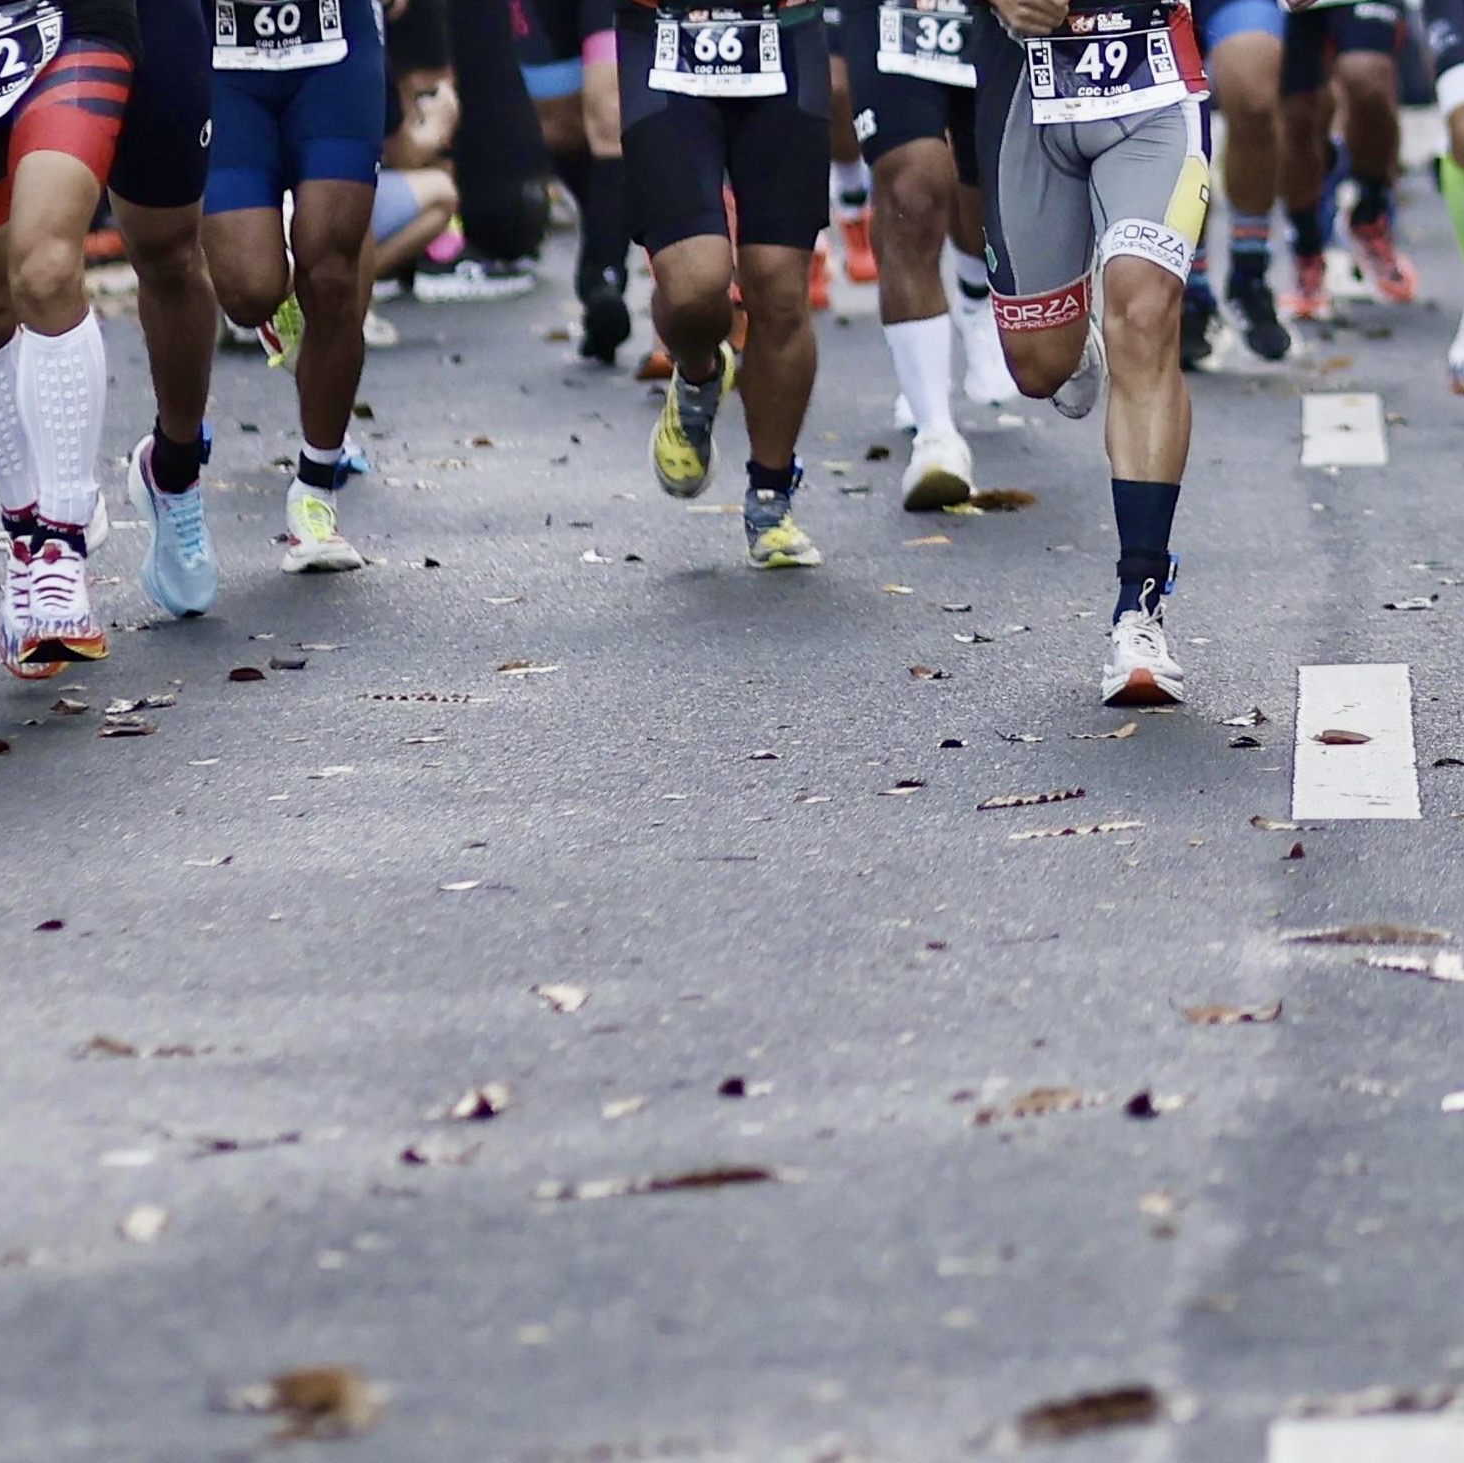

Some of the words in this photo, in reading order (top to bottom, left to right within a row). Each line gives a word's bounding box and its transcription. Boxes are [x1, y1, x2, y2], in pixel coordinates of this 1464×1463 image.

[253, 3, 301, 37] 60
[916, 16, 964, 52] 36
[694, 26, 743, 62] 66
[1074, 40, 1129, 81] 49
[715, 64, 742, 74] LONG
[1077, 86, 1102, 97] CDC
